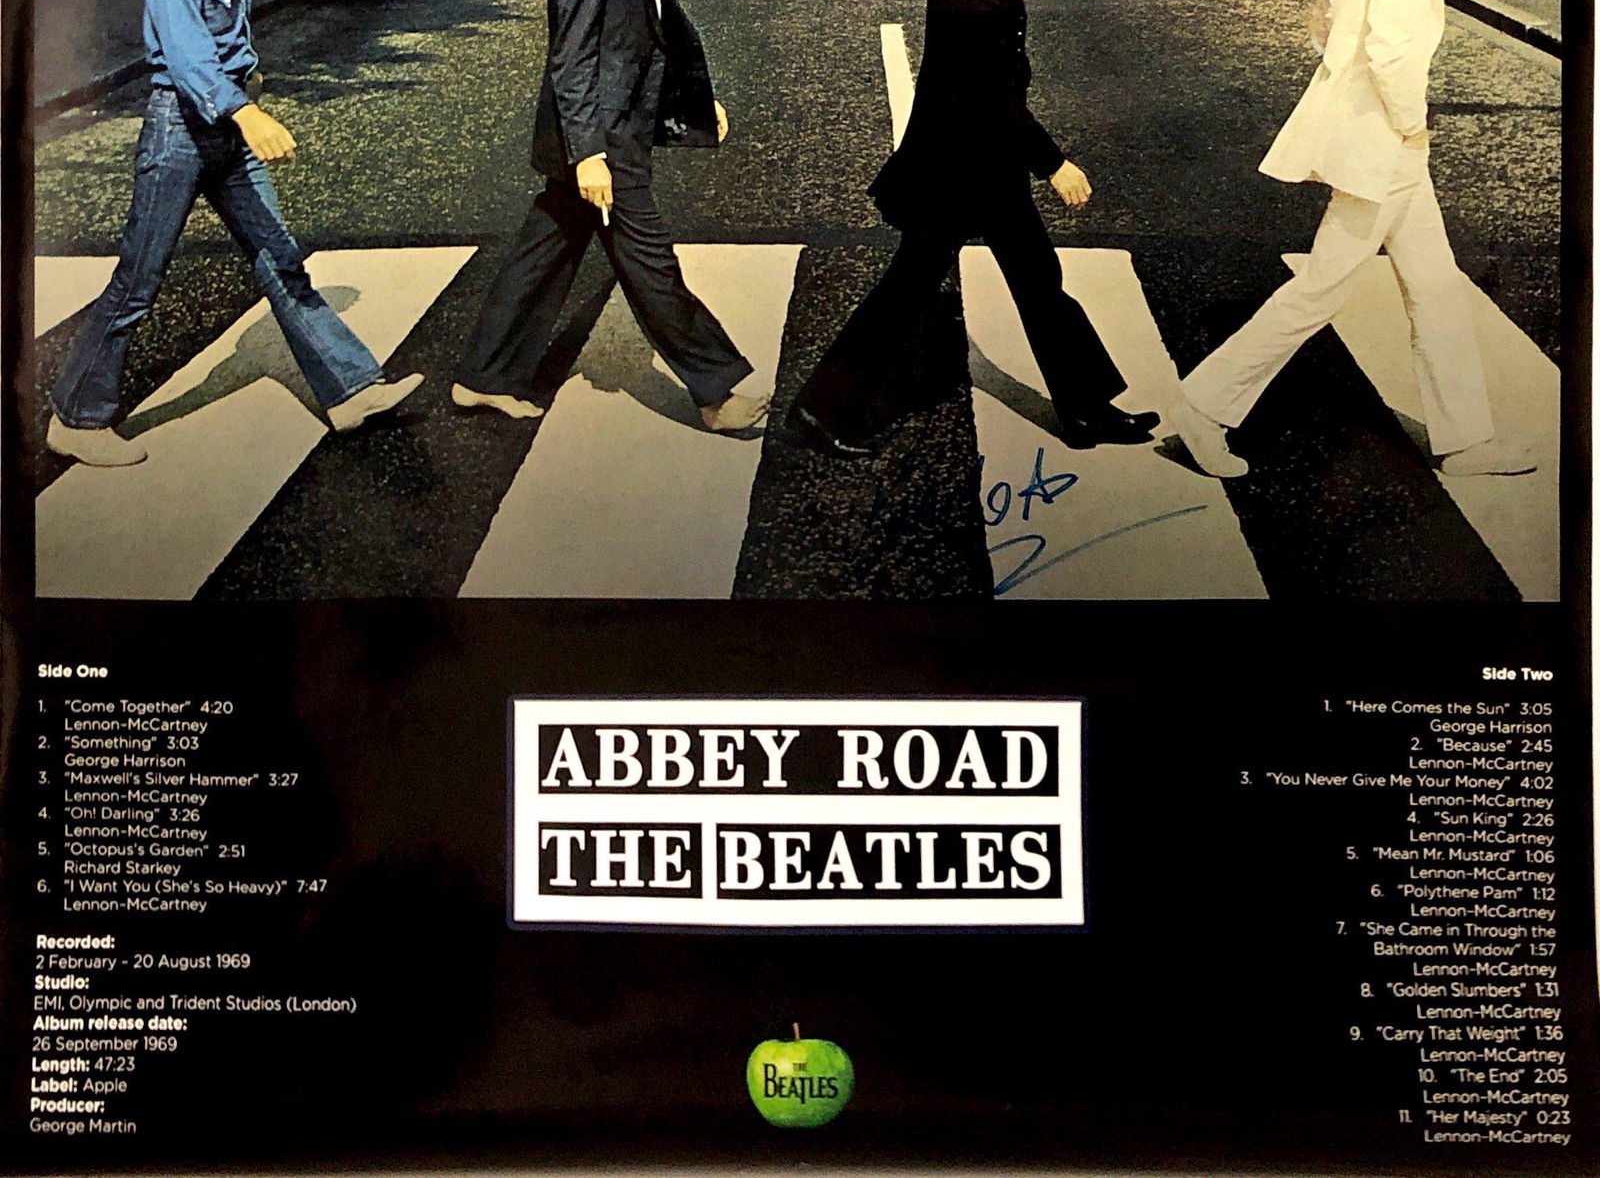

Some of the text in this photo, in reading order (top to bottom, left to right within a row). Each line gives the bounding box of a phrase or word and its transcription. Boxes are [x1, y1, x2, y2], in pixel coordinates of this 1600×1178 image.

[38, 664, 108, 678] Side One
[1482, 667, 1553, 681] Side Two
[65, 700, 115, 712] "Come
[120, 700, 190, 715] Together"
[200, 701, 233, 714] 4:20
[1346, 700, 1387, 713] "Here
[1392, 701, 1442, 713] Comes
[1447, 703, 1472, 714] the
[1477, 702, 1510, 714] Sun"
[1520, 703, 1552, 715] 3:05
[65, 718, 207, 734] Lennon-McCartney
[1430, 719, 1552, 735] George Harrison
[65, 735, 157, 751] "Something"
[167, 736, 199, 750] 3:03
[1437, 738, 1512, 752] "Because"
[1521, 739, 1552, 753] 2:45
[65, 753, 185, 769] George Harrison
[541, 728, 1049, 791] ABBEY ROAD
[1410, 756, 1553, 773] Lennon-McCartney
[65, 772, 140, 784] "Maxwell's
[146, 772, 185, 785] Silver
[190, 773, 259, 786] Hammer"
[269, 773, 298, 786] 3:27
[1266, 773, 1300, 785] "You
[1305, 773, 1347, 785] Never
[1353, 773, 1386, 786] Give
[1390, 774, 1412, 787] Me
[1417, 775, 1451, 787] Your
[1456, 775, 1510, 790] Money"
[1520, 776, 1553, 789] 4:02
[65, 790, 207, 806] Lennon-McCartney
[1410, 793, 1553, 810] Lennon-McCartney
[65, 807, 96, 819] "Oh!
[102, 807, 159, 822] Darling"
[170, 808, 200, 821] 3:26
[1434, 811, 1468, 824] "Sun
[1473, 812, 1513, 827] King"
[1523, 813, 1554, 826] 2:26
[65, 824, 207, 841] Lennon-McCartney
[1410, 830, 1554, 847] Lennon-McCartney
[65, 842, 144, 856] "Octopus's
[149, 843, 208, 857] Garden"
[219, 845, 245, 857] 2:51
[1373, 847, 1418, 859] "Mean
[1424, 848, 1444, 860] Mr.
[1449, 848, 1515, 862] Mustard"
[1526, 850, 1554, 863] 1:06
[65, 860, 181, 876] Richard Starkey
[541, 829, 1052, 891] THE BEATLES
[1410, 866, 1555, 884] Lennon-McCartney
[79, 879, 117, 892] Want
[123, 880, 150, 892] You
[155, 879, 200, 894] (She's
[205, 880, 224, 893] So
[229, 880, 287, 895] Heavy)"
[297, 879, 327, 892] 7:47
[1398, 884, 1479, 900] "Polythene
[1483, 886, 1522, 899] Pam"
[1533, 887, 1555, 901] 1:12
[64, 897, 207, 912] Lennon-McCartney
[1411, 903, 1555, 921] Lennon-McCartney
[1360, 922, 1395, 935] "She
[1399, 922, 1443, 936] Came
[1446, 923, 1460, 935] in
[1464, 923, 1527, 939] Through
[1532, 925, 1556, 938] the
[37, 934, 115, 949] Recorded:
[1374, 941, 1556, 956] Bathroom Window" 1:57
[36, 955, 44, 969] 2
[49, 954, 116, 971] February
[134, 954, 153, 968] 20
[158, 954, 211, 971] August
[217, 954, 250, 968] 1969
[1413, 962, 1556, 978] Lennon-McCartney
[35, 974, 89, 990] Studio:
[1387, 982, 1447, 997] "Golden
[1451, 982, 1526, 997] Slumbers"
[1535, 982, 1559, 997] 1:31
[34, 995, 356, 1013] EMI, Olympic and Trident Studios (London)
[1417, 1004, 1561, 1021] Lennon-McCartney
[33, 1015, 187, 1031] Album release date:
[1376, 1026, 1424, 1043] "Carry
[1429, 1026, 1462, 1040] That
[1466, 1026, 1526, 1043] Weight"
[1535, 1025, 1563, 1040] 1:36
[32, 1036, 177, 1052] 26 September 1969
[1421, 1047, 1565, 1065] Lennon-McCartney
[32, 1056, 135, 1075] Length: 47:23
[1451, 1068, 1485, 1083] "The
[1489, 1068, 1525, 1083] End"
[1534, 1068, 1567, 1083] 2:05
[31, 1077, 127, 1094] Label: Apple
[763, 1063, 839, 1105] BEATLES
[31, 1097, 104, 1113] Producer:
[1423, 1089, 1569, 1107] Lennon-McCartney
[30, 1117, 136, 1135] George Martin
[1427, 1110, 1459, 1123] "Her
[1464, 1110, 1527, 1126] Majesty"
[1537, 1110, 1570, 1124] 0:23
[1425, 1130, 1571, 1145] Lennon-McCartney
